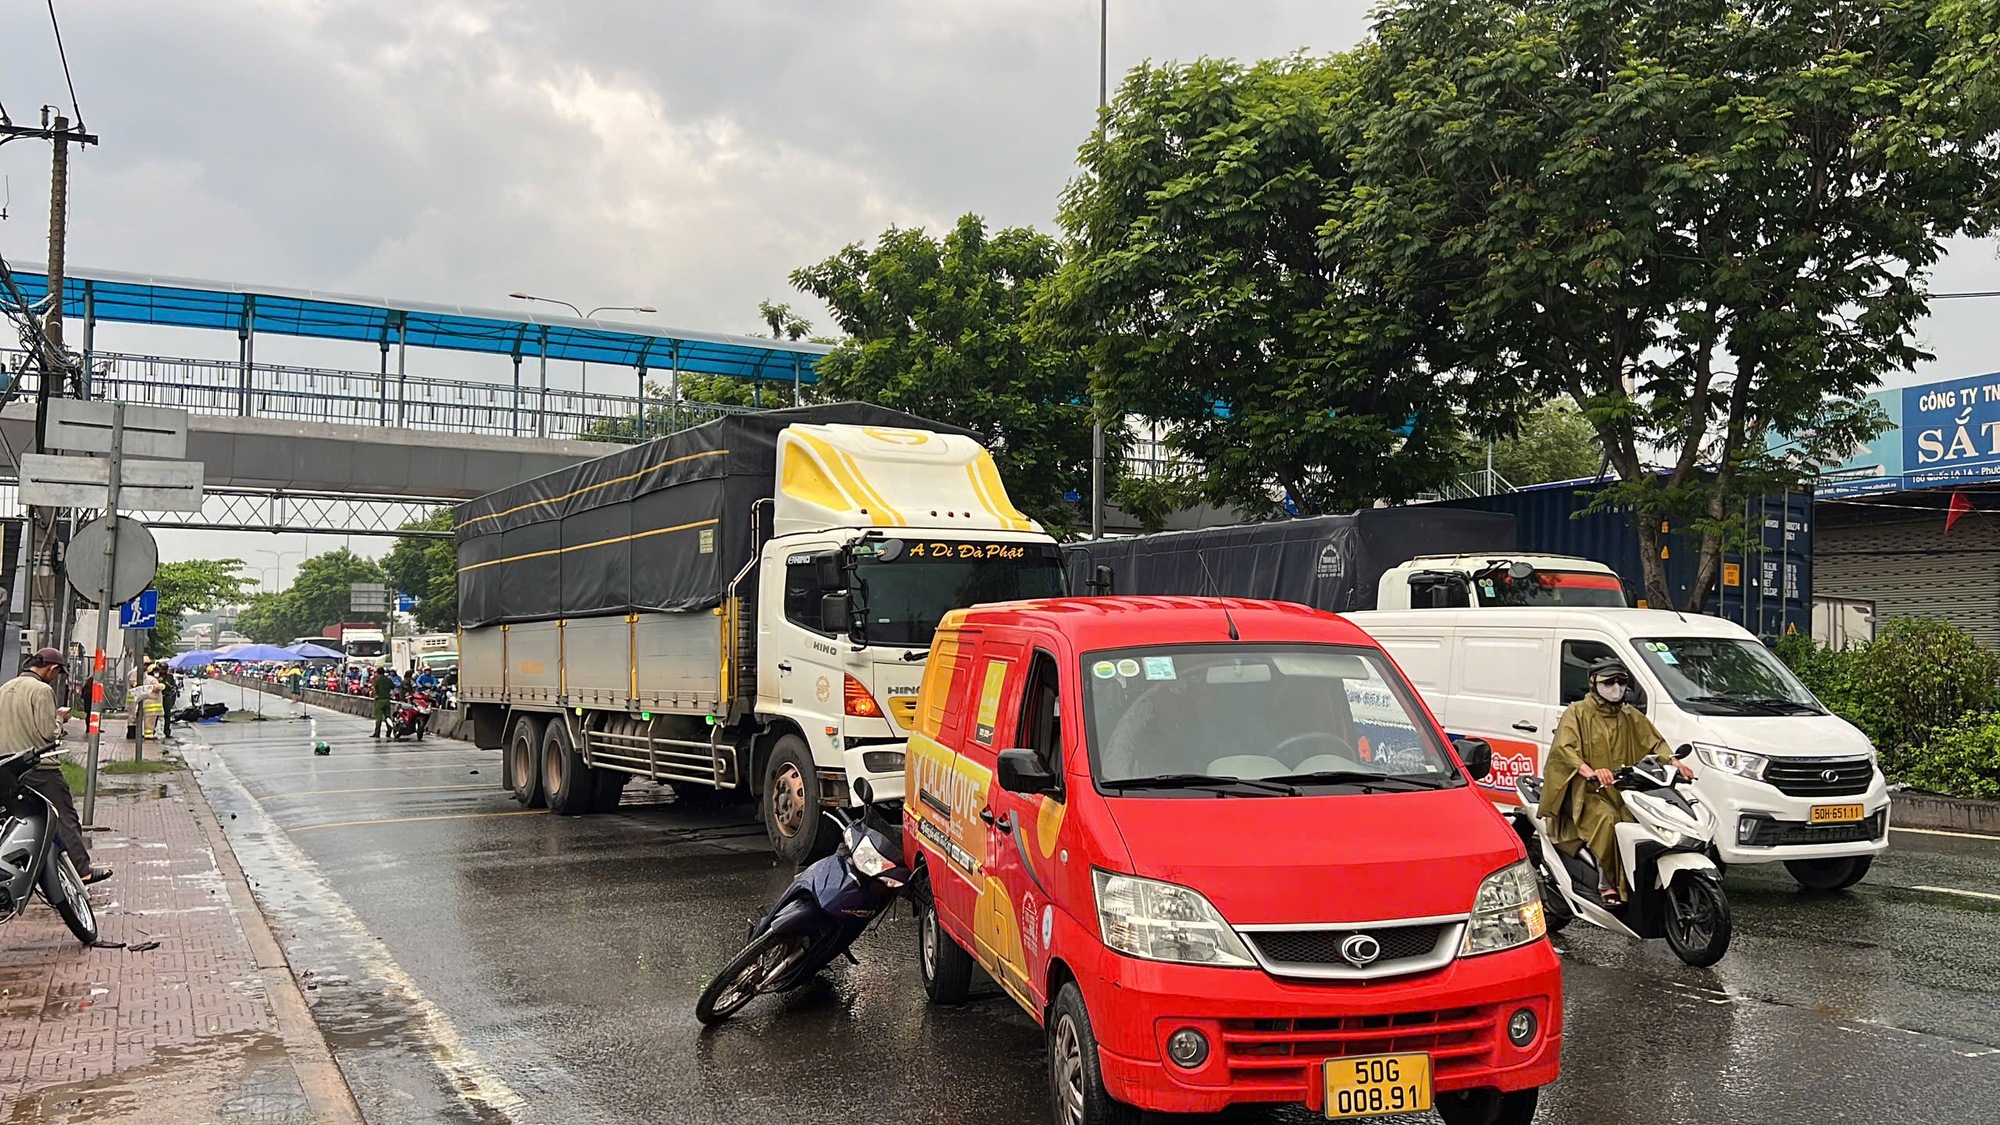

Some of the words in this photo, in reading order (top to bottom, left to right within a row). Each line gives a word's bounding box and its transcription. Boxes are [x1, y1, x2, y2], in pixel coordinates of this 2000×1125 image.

[1919, 390, 1956, 412] CÔNG
[1960, 387, 1978, 406] TY
[1917, 406, 2000, 464] SẮT
[793, 555, 811, 565] HINO
[909, 543, 925, 557] A
[930, 543, 954, 557] Di
[957, 544, 985, 558] Đà
[985, 544, 1024, 560] Phật
[813, 641, 837, 656] HINO
[1510, 757, 1530, 776] gia
[923, 751, 981, 826] LALAMOVE
[1814, 806, 1859, 820] 50H-651.11
[1355, 1058, 1400, 1085] 50G
[1338, 1085, 1418, 1114] 008.91
